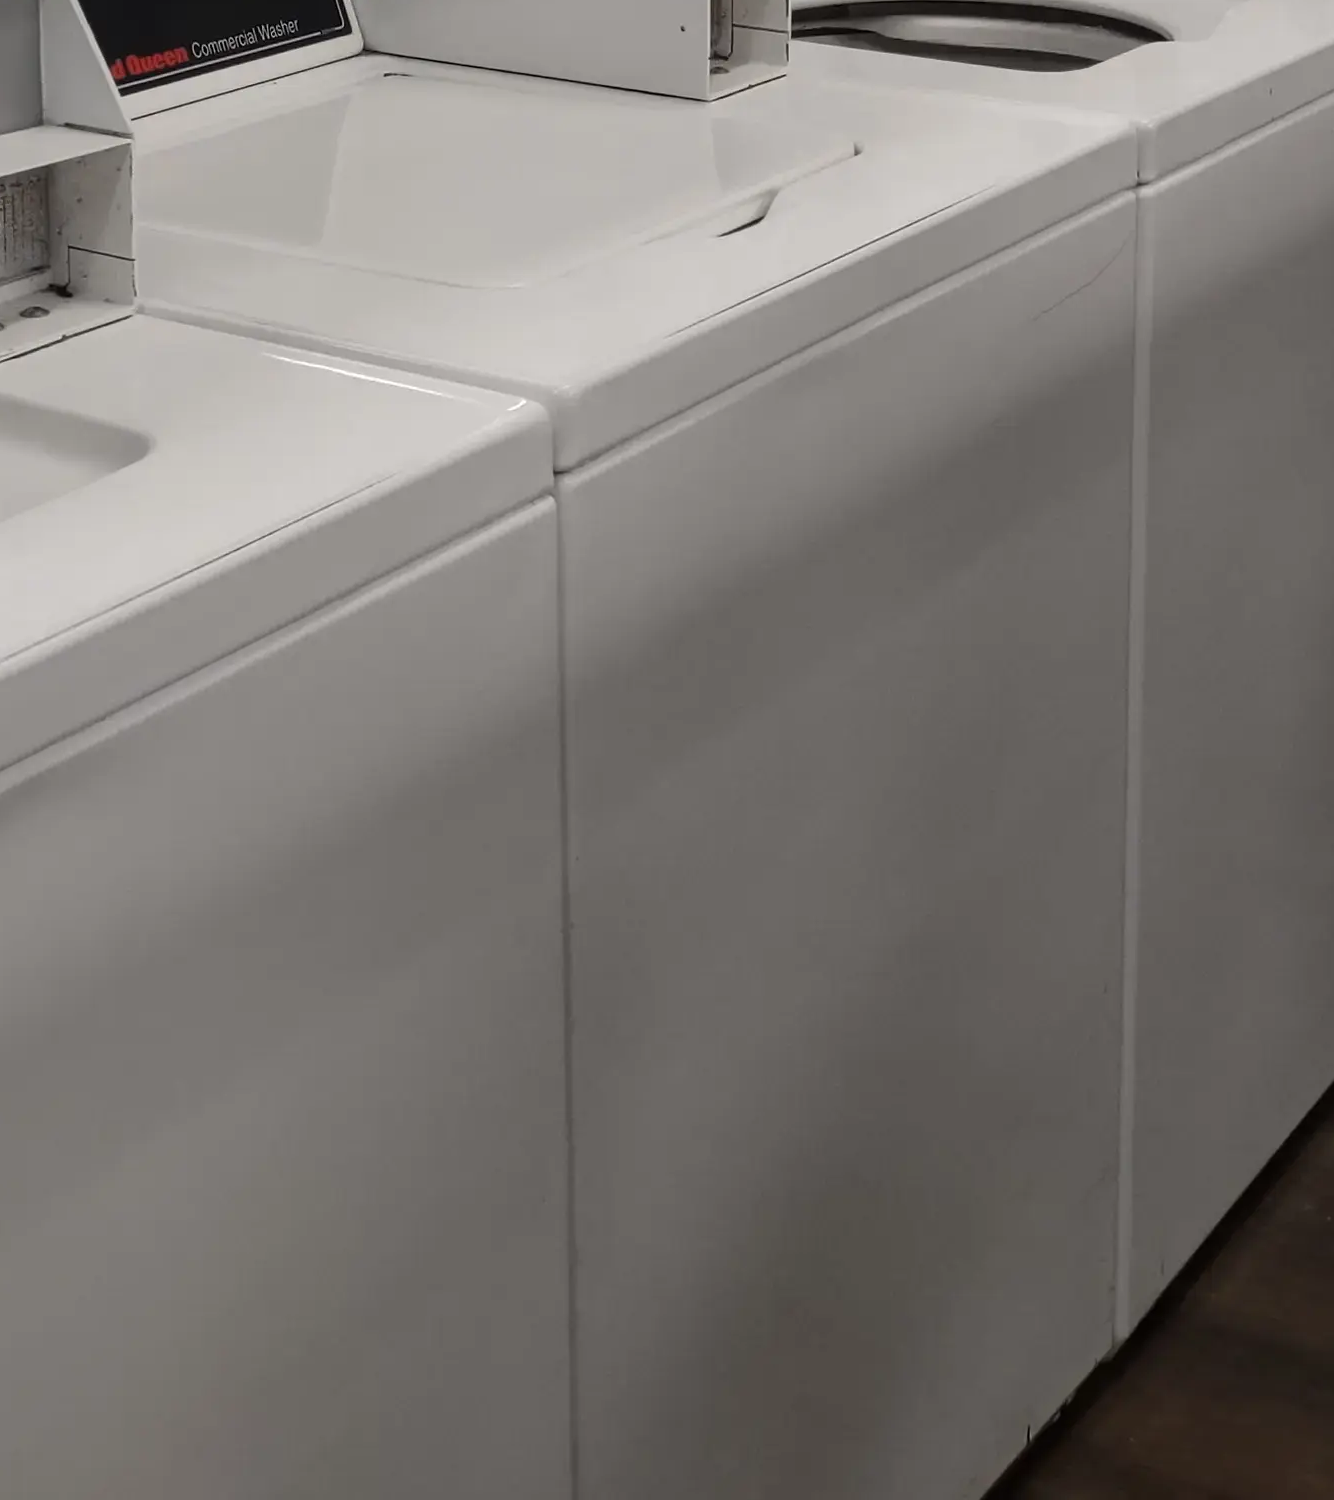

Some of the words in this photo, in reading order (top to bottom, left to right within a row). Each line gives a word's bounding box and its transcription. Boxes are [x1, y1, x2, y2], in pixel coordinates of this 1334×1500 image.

[126, 46, 189, 75] Queen
[191, 28, 257, 58] Commercial
[258, 19, 299, 40] Washer
